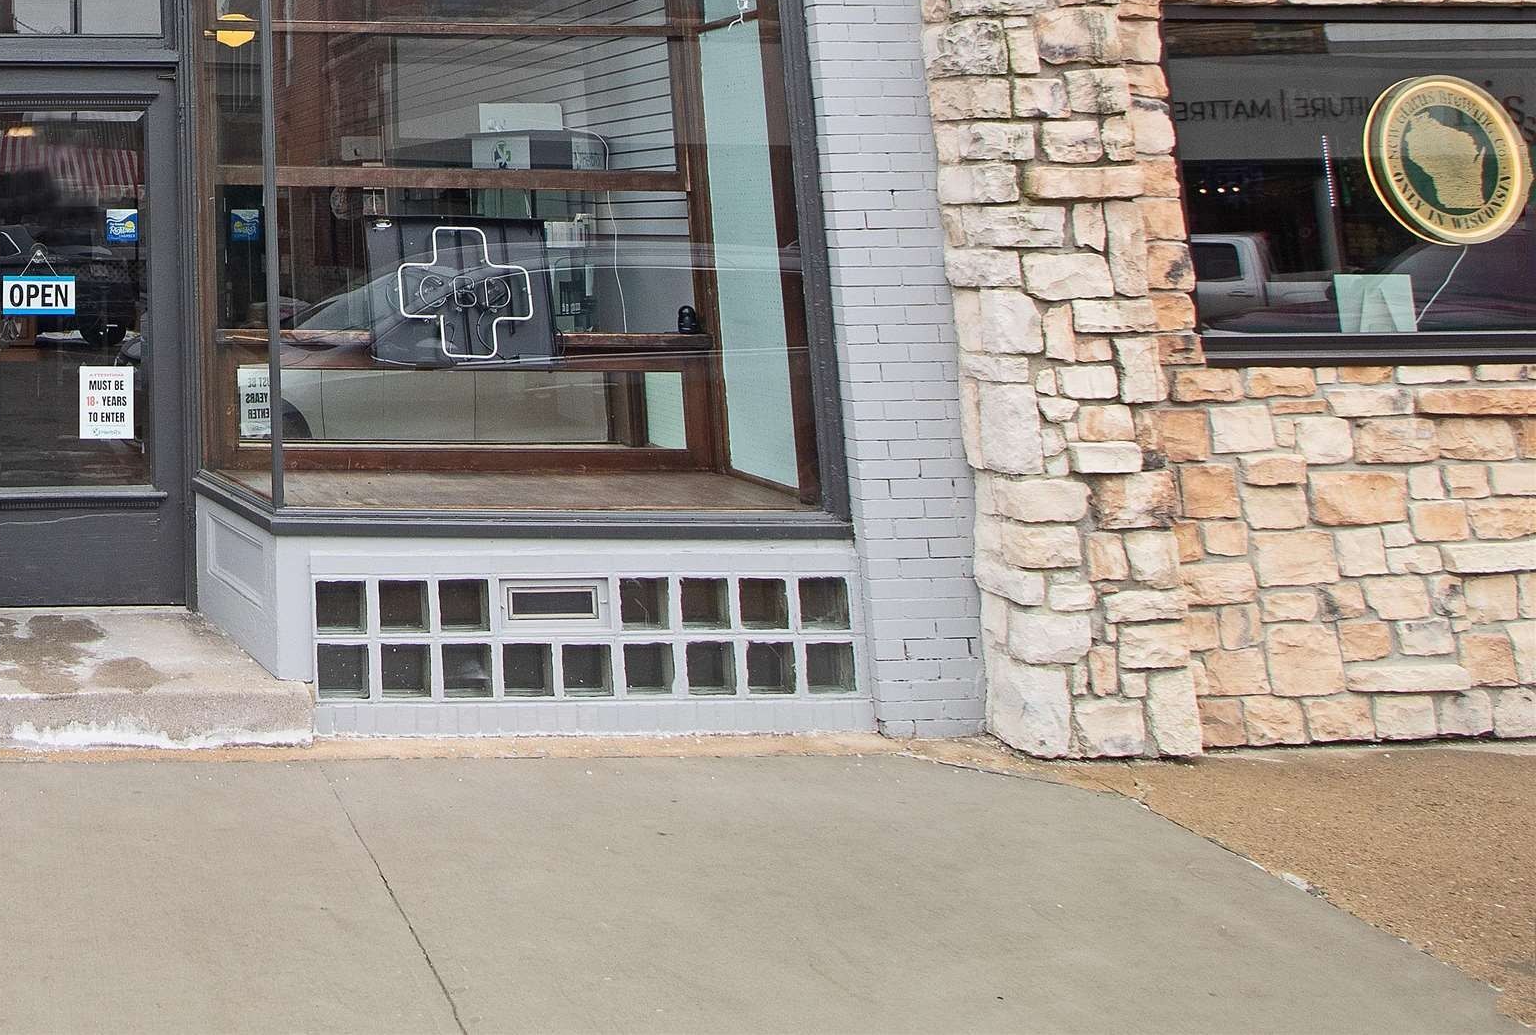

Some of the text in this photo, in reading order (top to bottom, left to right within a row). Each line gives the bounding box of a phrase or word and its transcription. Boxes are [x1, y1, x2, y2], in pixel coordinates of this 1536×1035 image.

[9, 283, 68, 307] OPEN
[88, 380, 124, 390] MUST BE
[102, 396, 127, 406] YEARS
[88, 412, 125, 422] TO ENTER
